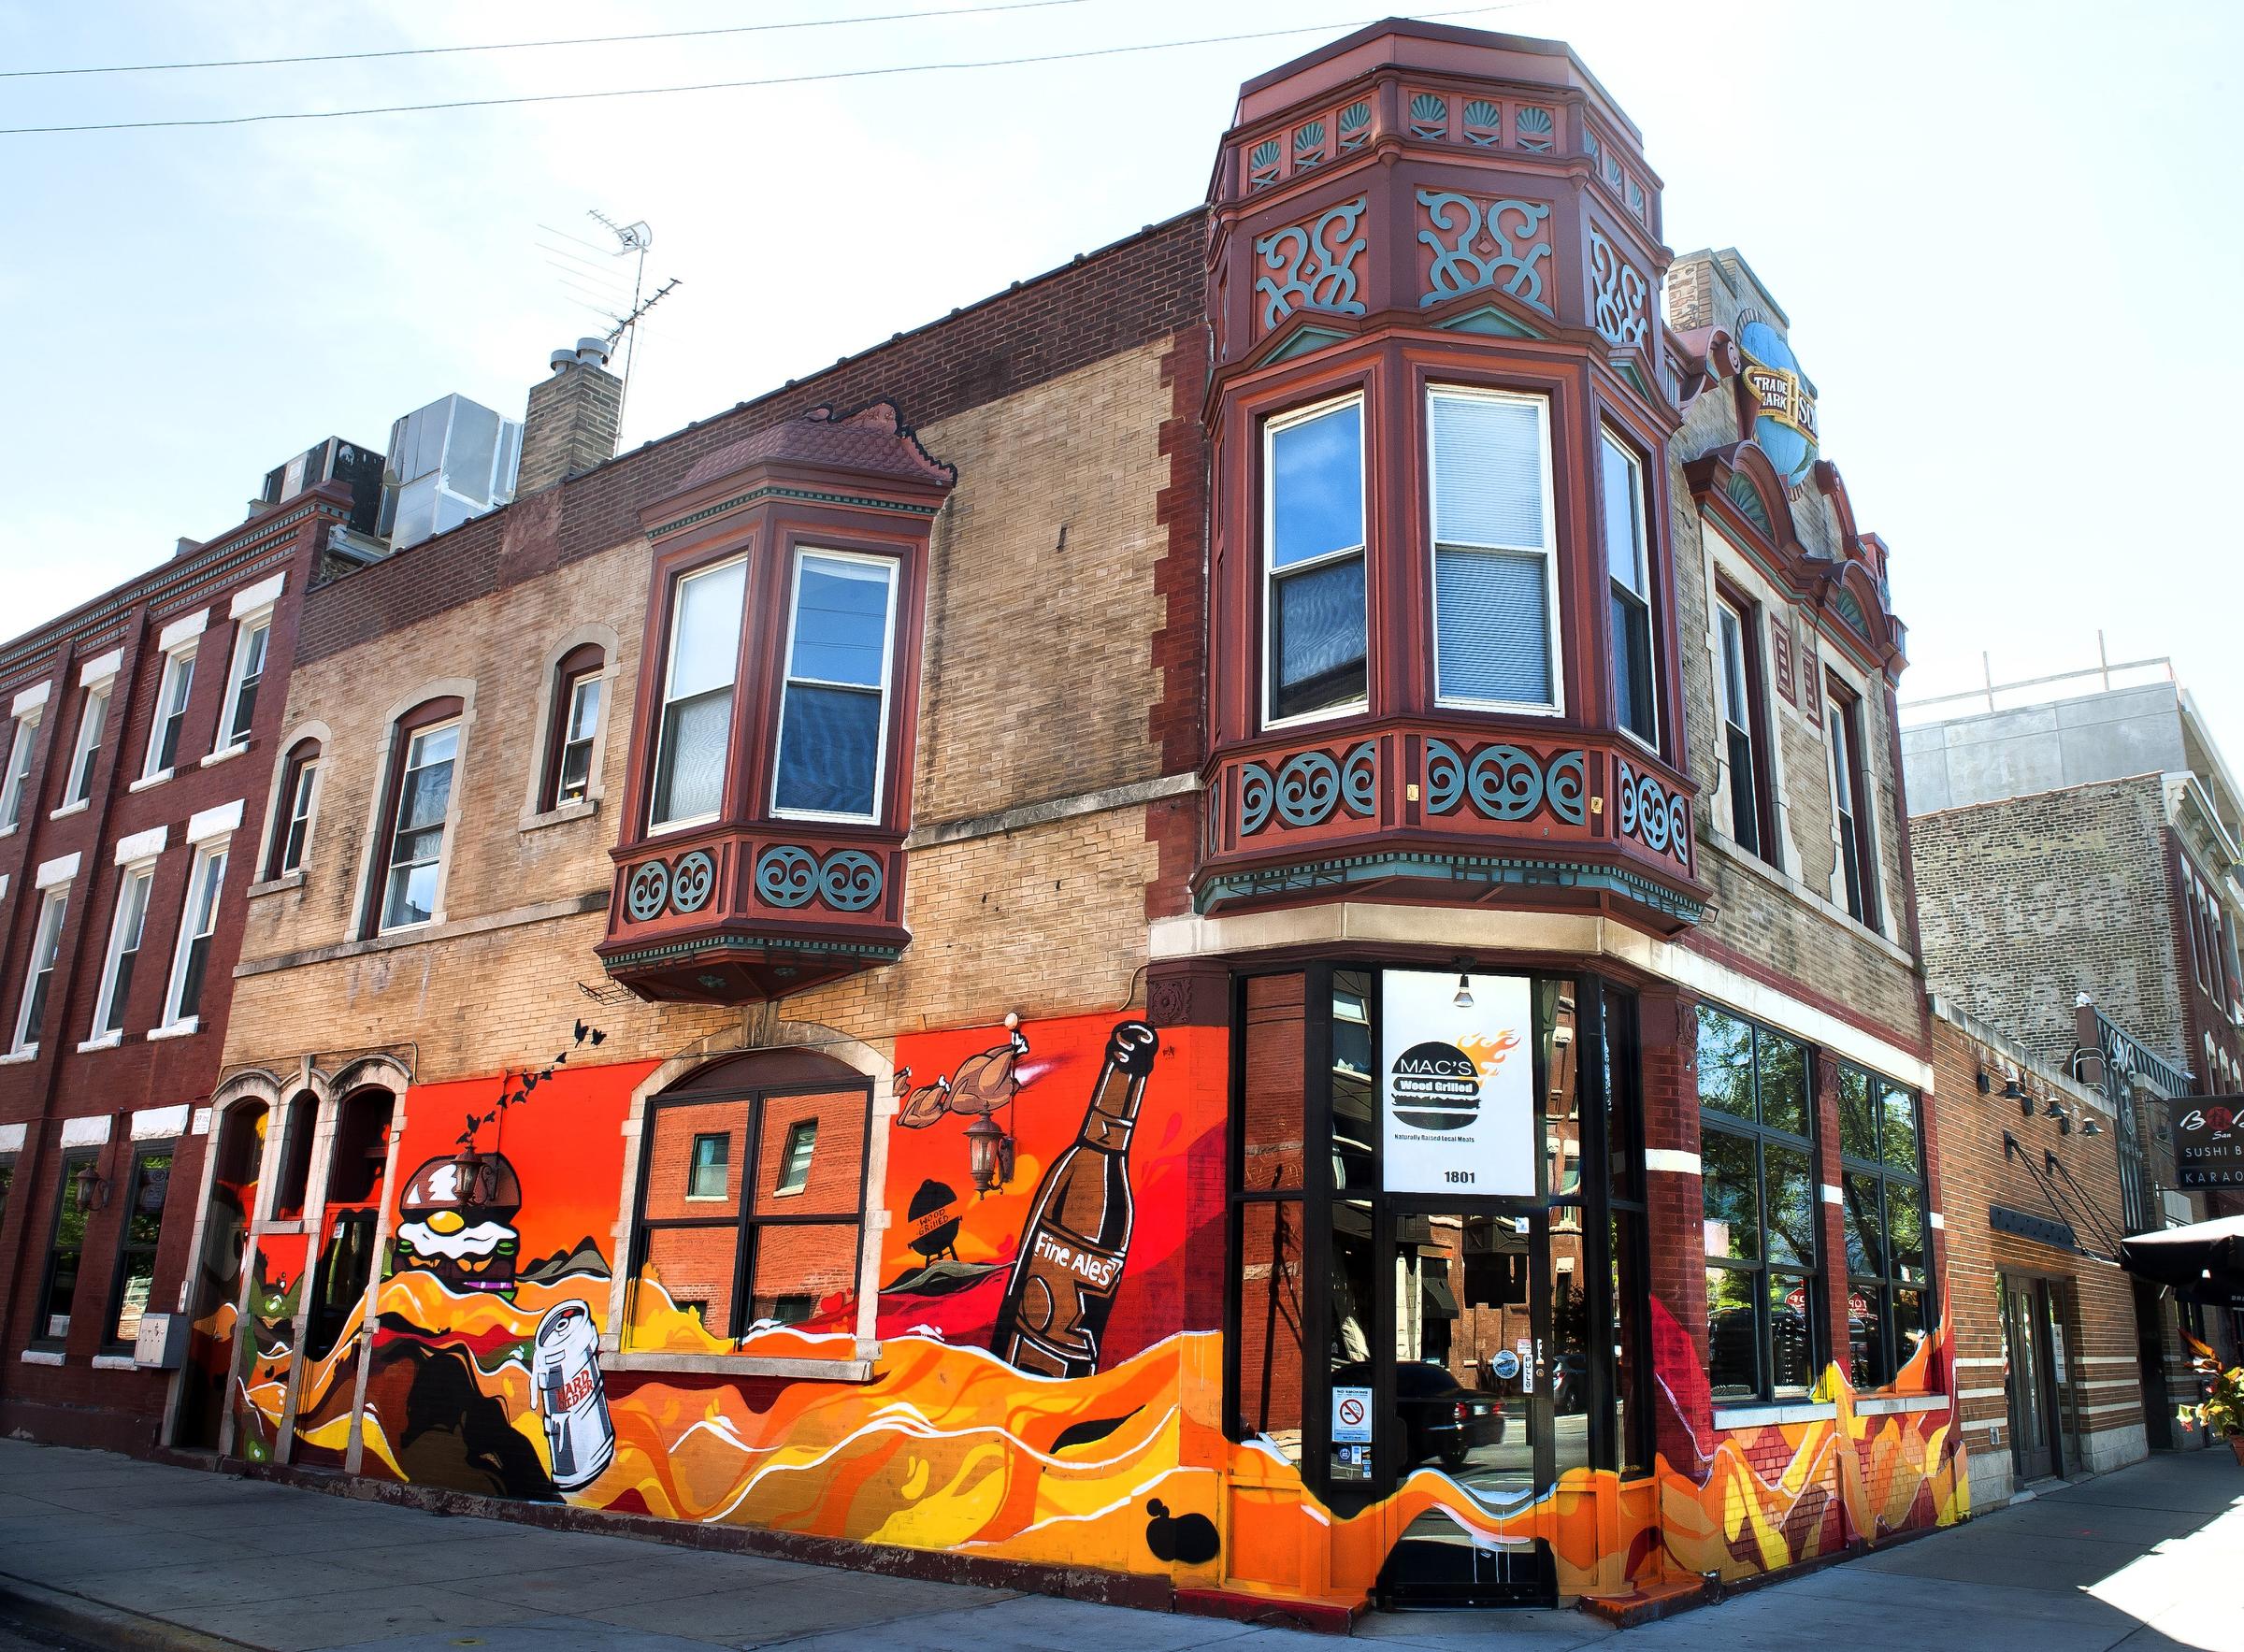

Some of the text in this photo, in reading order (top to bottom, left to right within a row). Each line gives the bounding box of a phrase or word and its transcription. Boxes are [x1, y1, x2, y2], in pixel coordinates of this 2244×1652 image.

[1753, 377, 1788, 395] TRADE
[1401, 1058, 1473, 1076] MAC'S
[1400, 1080, 1473, 1093] Wood Grilled
[2212, 1130, 2232, 1141] San
[2185, 1146, 2227, 1157] SUSHI
[1445, 1171, 1475, 1184] 1801
[2185, 1171, 2244, 1183] KARAO
[919, 1209, 945, 1226] WOOD
[1034, 1231, 1113, 1286] Fine Ales
[555, 1370, 589, 1402] HARD
[558, 1379, 593, 1412] CIDER
